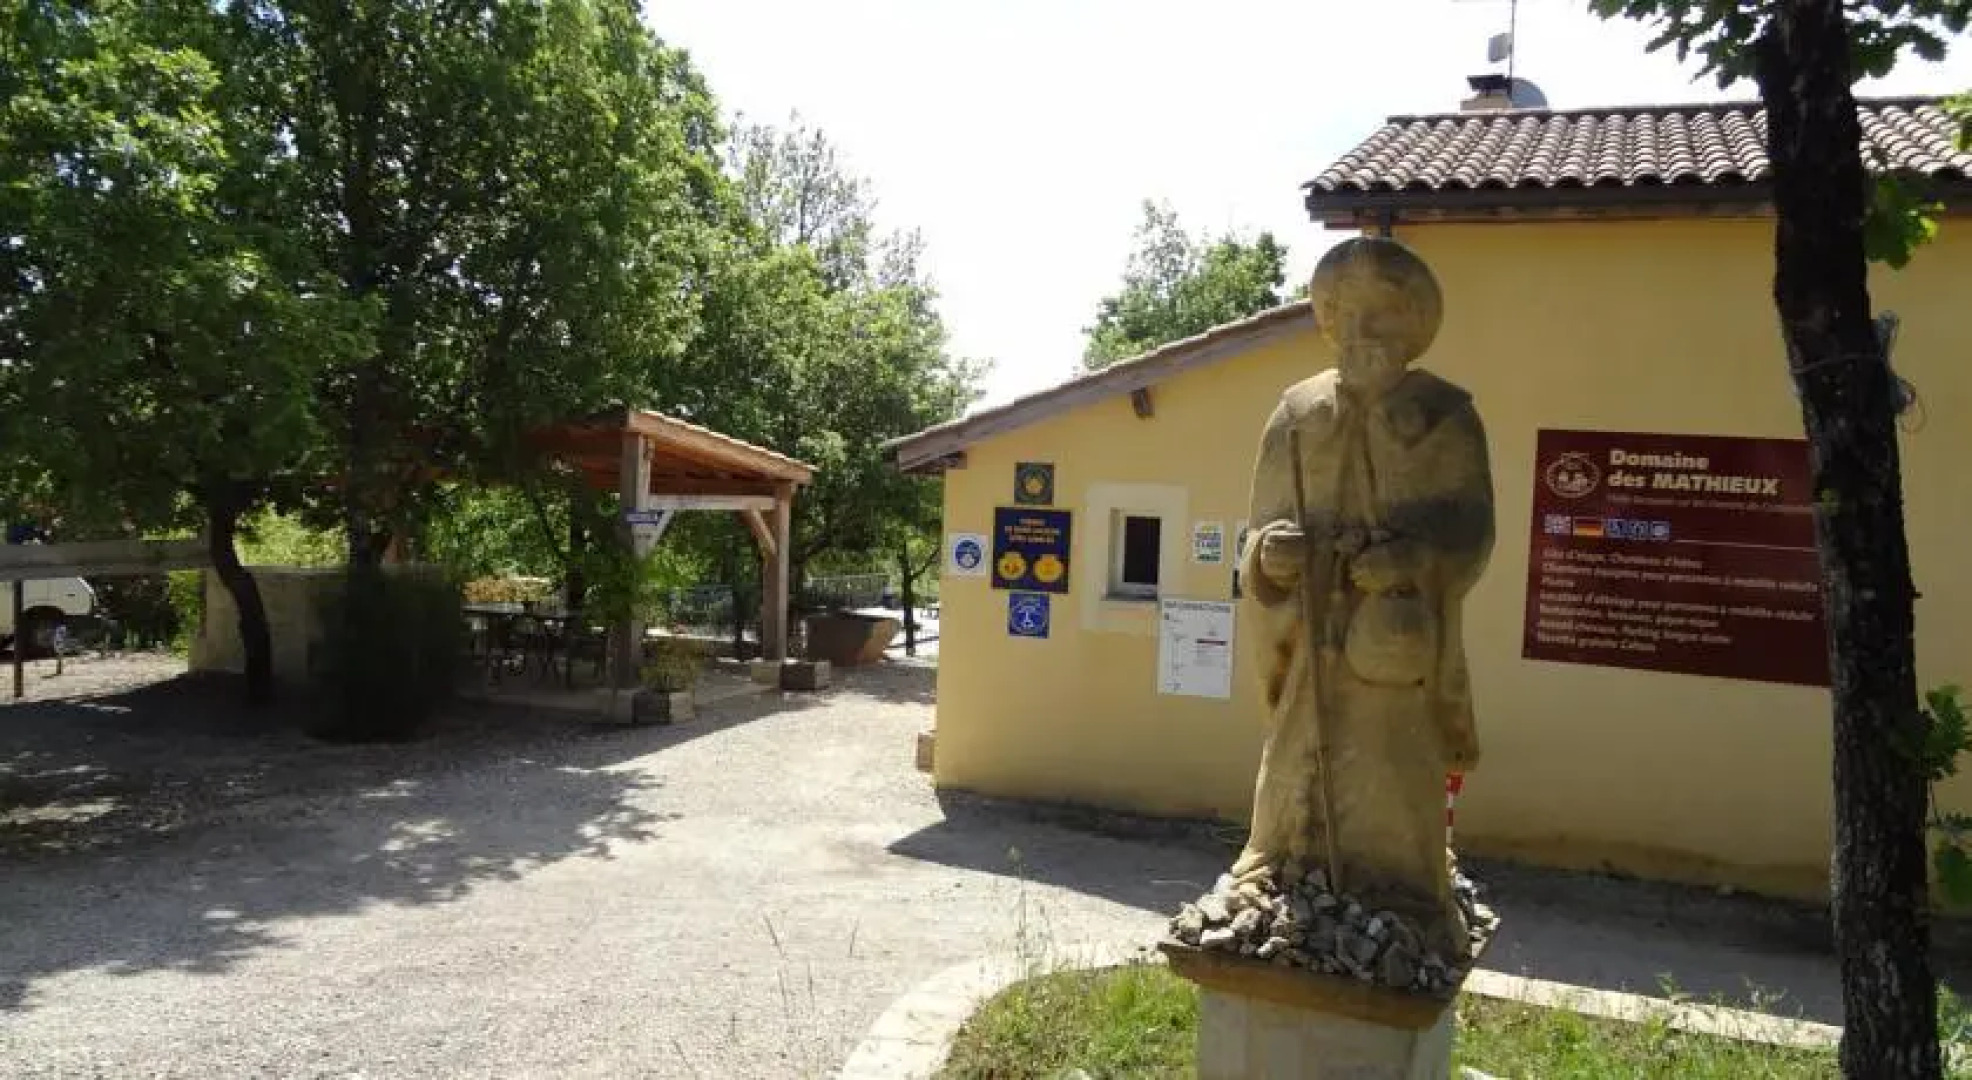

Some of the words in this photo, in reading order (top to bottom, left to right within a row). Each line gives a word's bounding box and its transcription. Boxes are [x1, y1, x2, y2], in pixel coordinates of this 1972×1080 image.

[1609, 448, 1710, 470] Domaine
[1607, 469, 1646, 487] des
[1652, 473, 1779, 495] MATHIEUX
